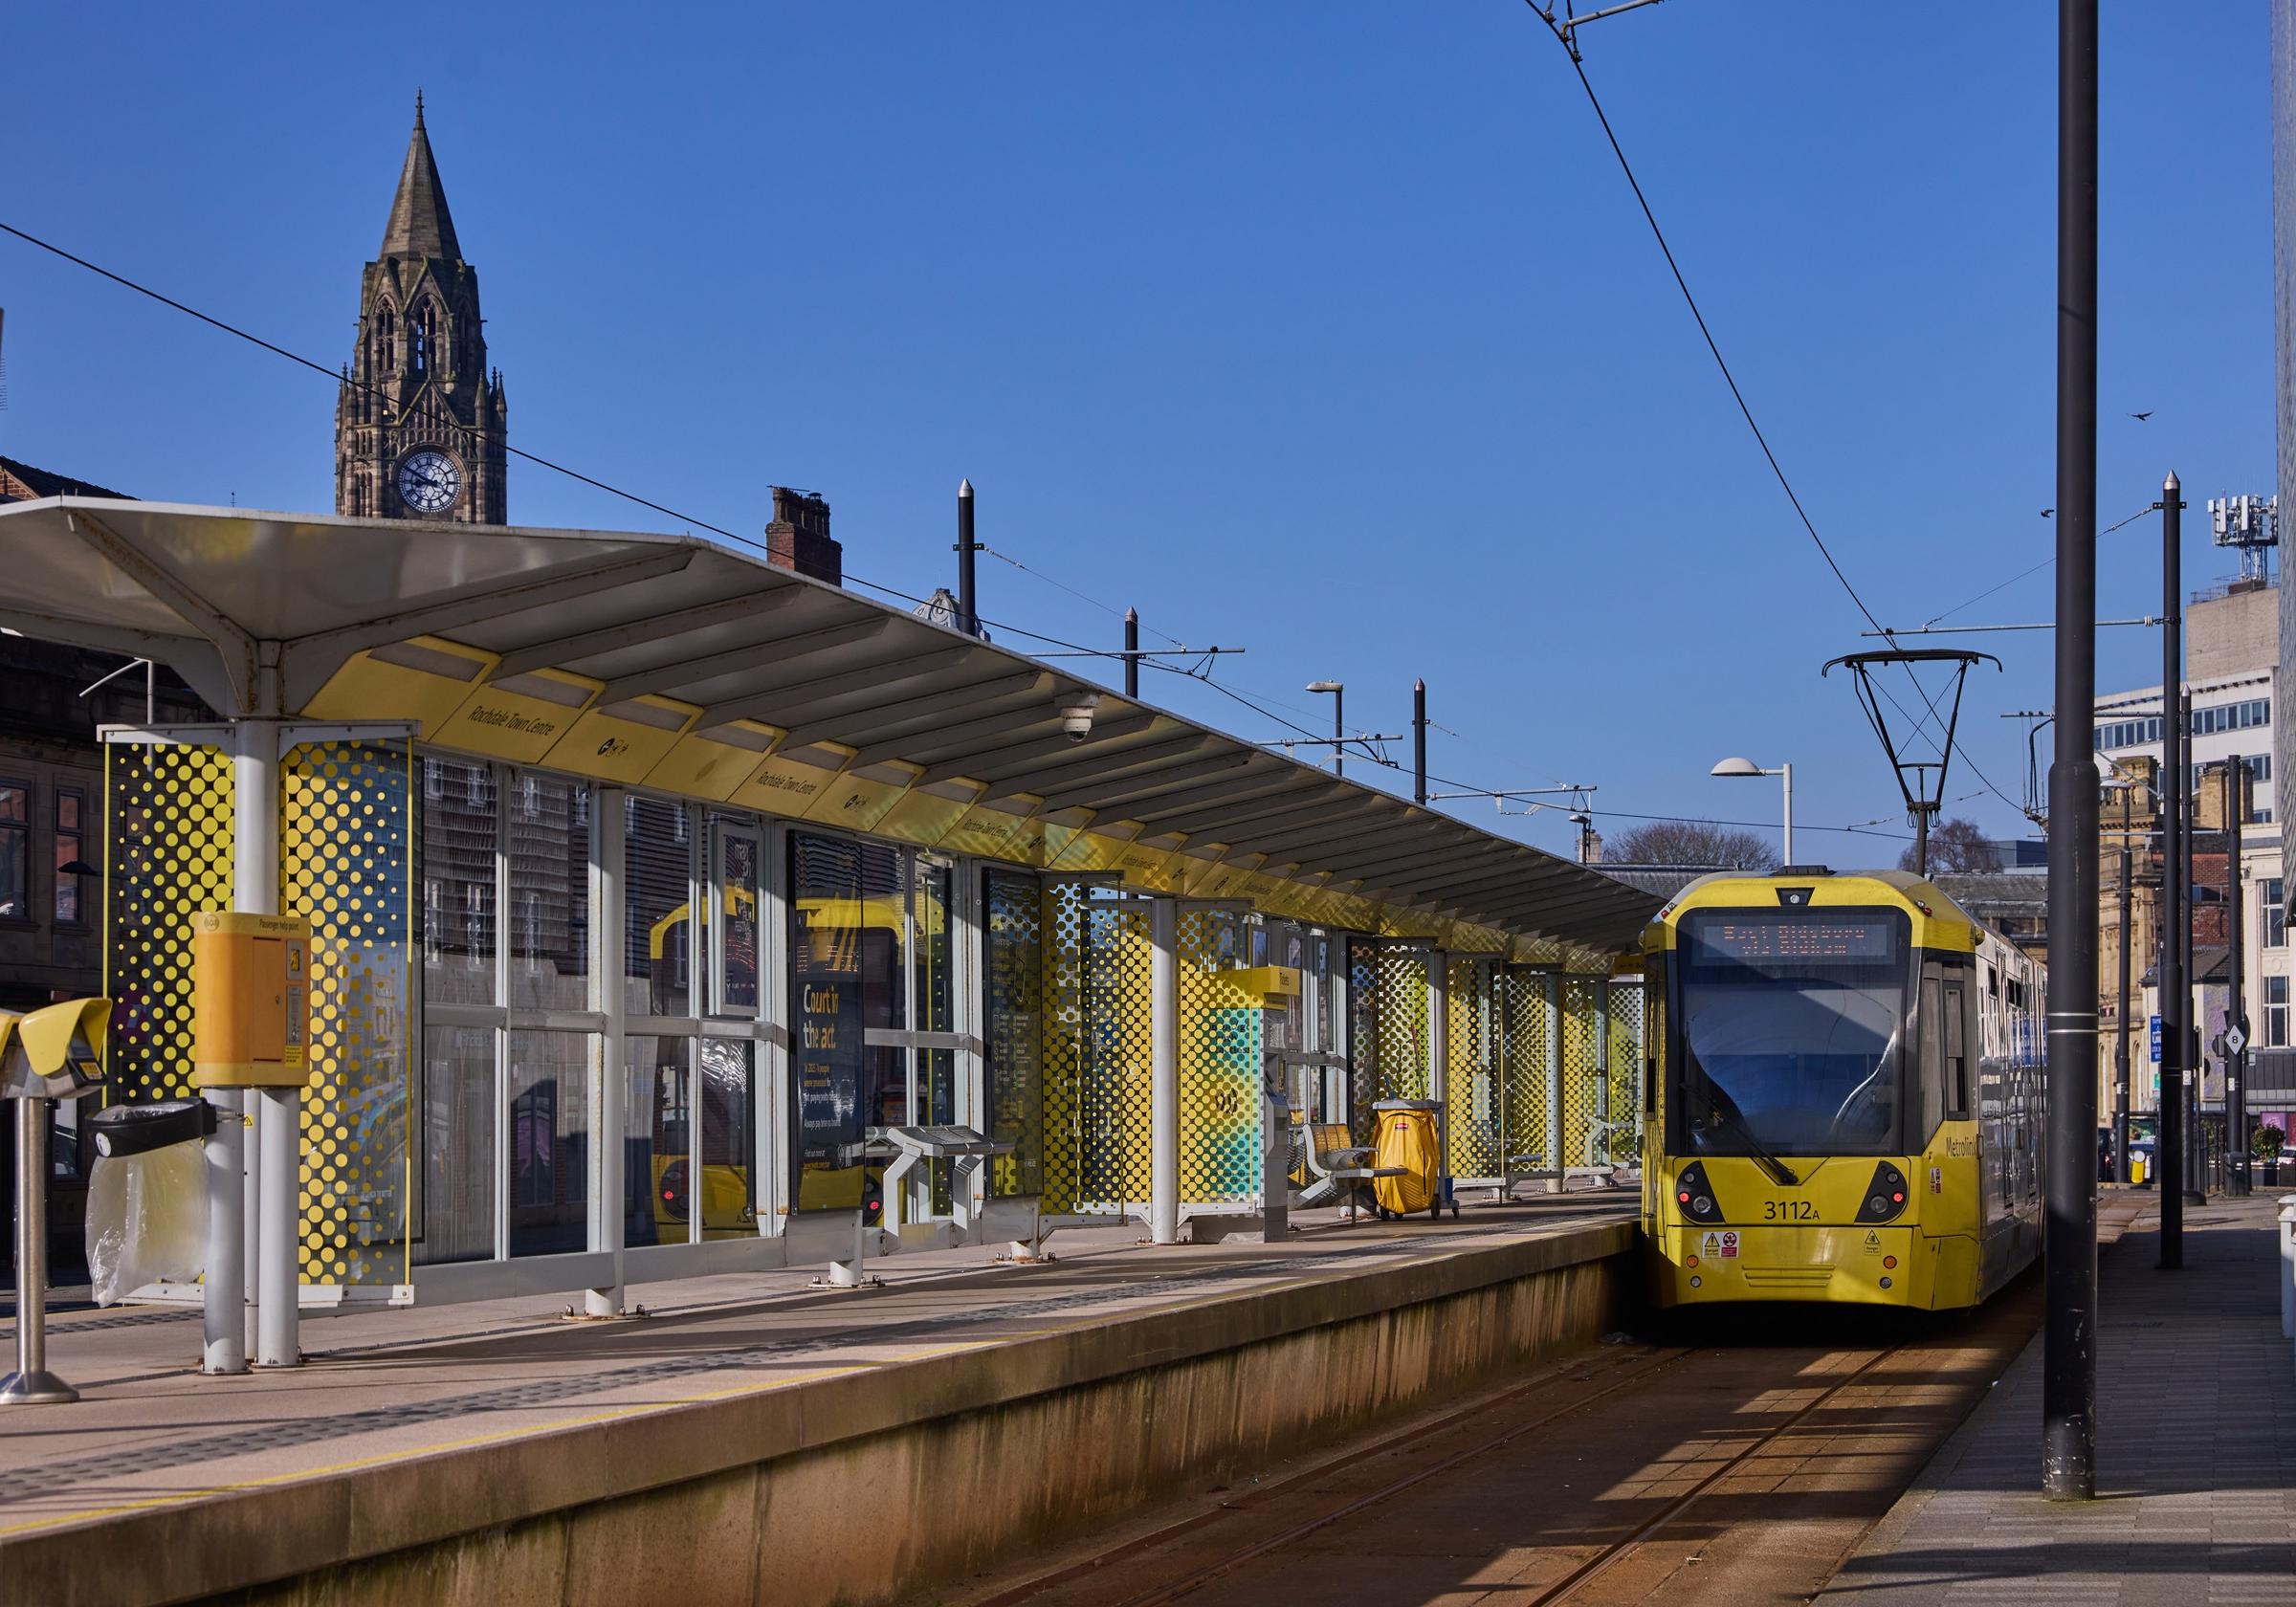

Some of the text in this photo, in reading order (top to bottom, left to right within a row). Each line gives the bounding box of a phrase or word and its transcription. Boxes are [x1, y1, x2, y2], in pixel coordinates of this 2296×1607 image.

[468, 705, 555, 737] Rochdale Town Centre
[804, 983, 839, 1014] Court in
[804, 1020, 837, 1049] the act.
[2232, 1035, 2239, 1045] 8
